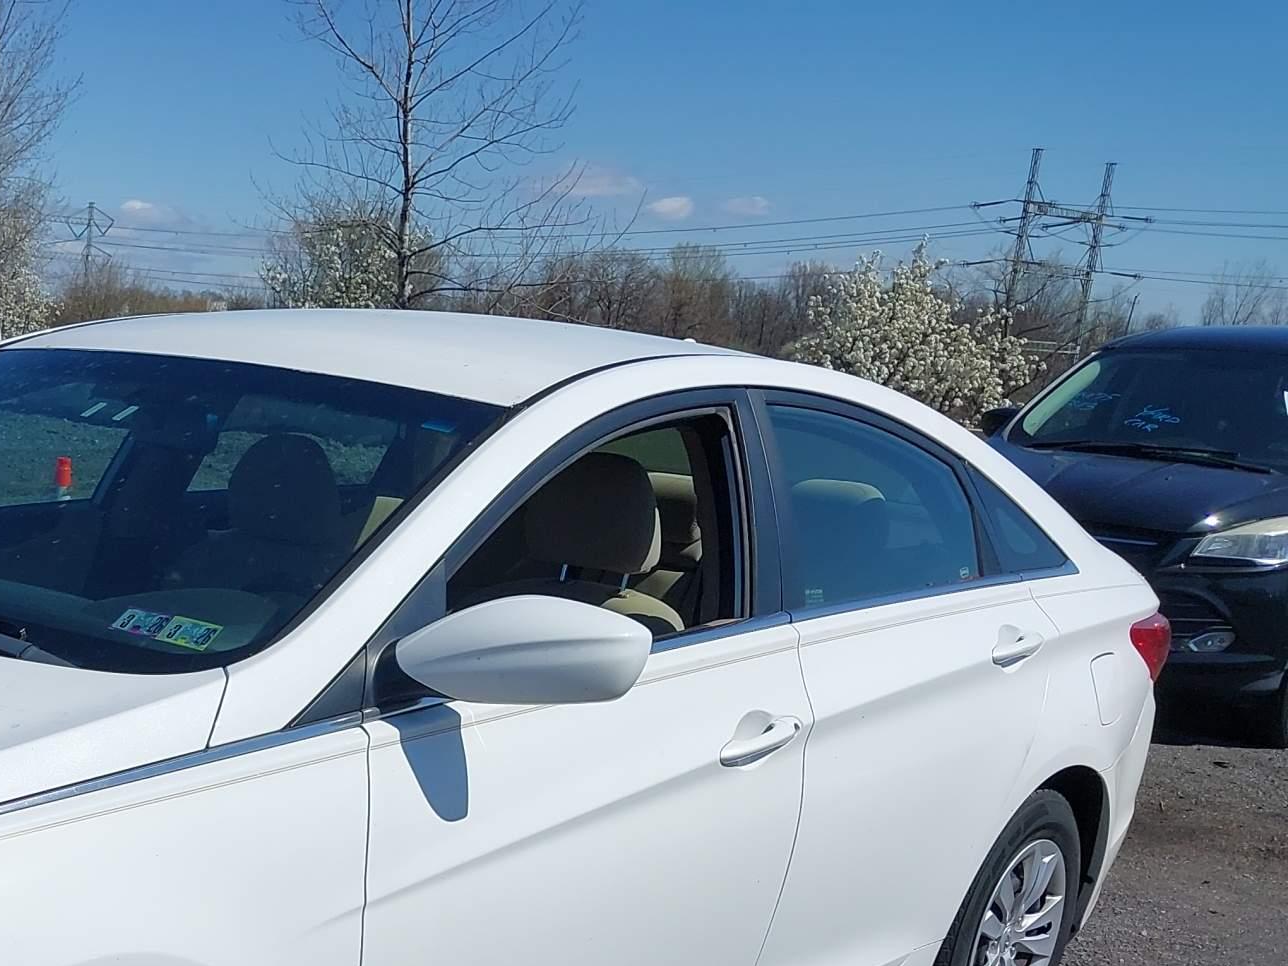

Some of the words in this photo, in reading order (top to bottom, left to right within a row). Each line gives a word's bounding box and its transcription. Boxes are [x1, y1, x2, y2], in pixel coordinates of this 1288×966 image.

[119, 614, 136, 628] 3
[166, 624, 183, 639] 3
[194, 627, 218, 646] 26
